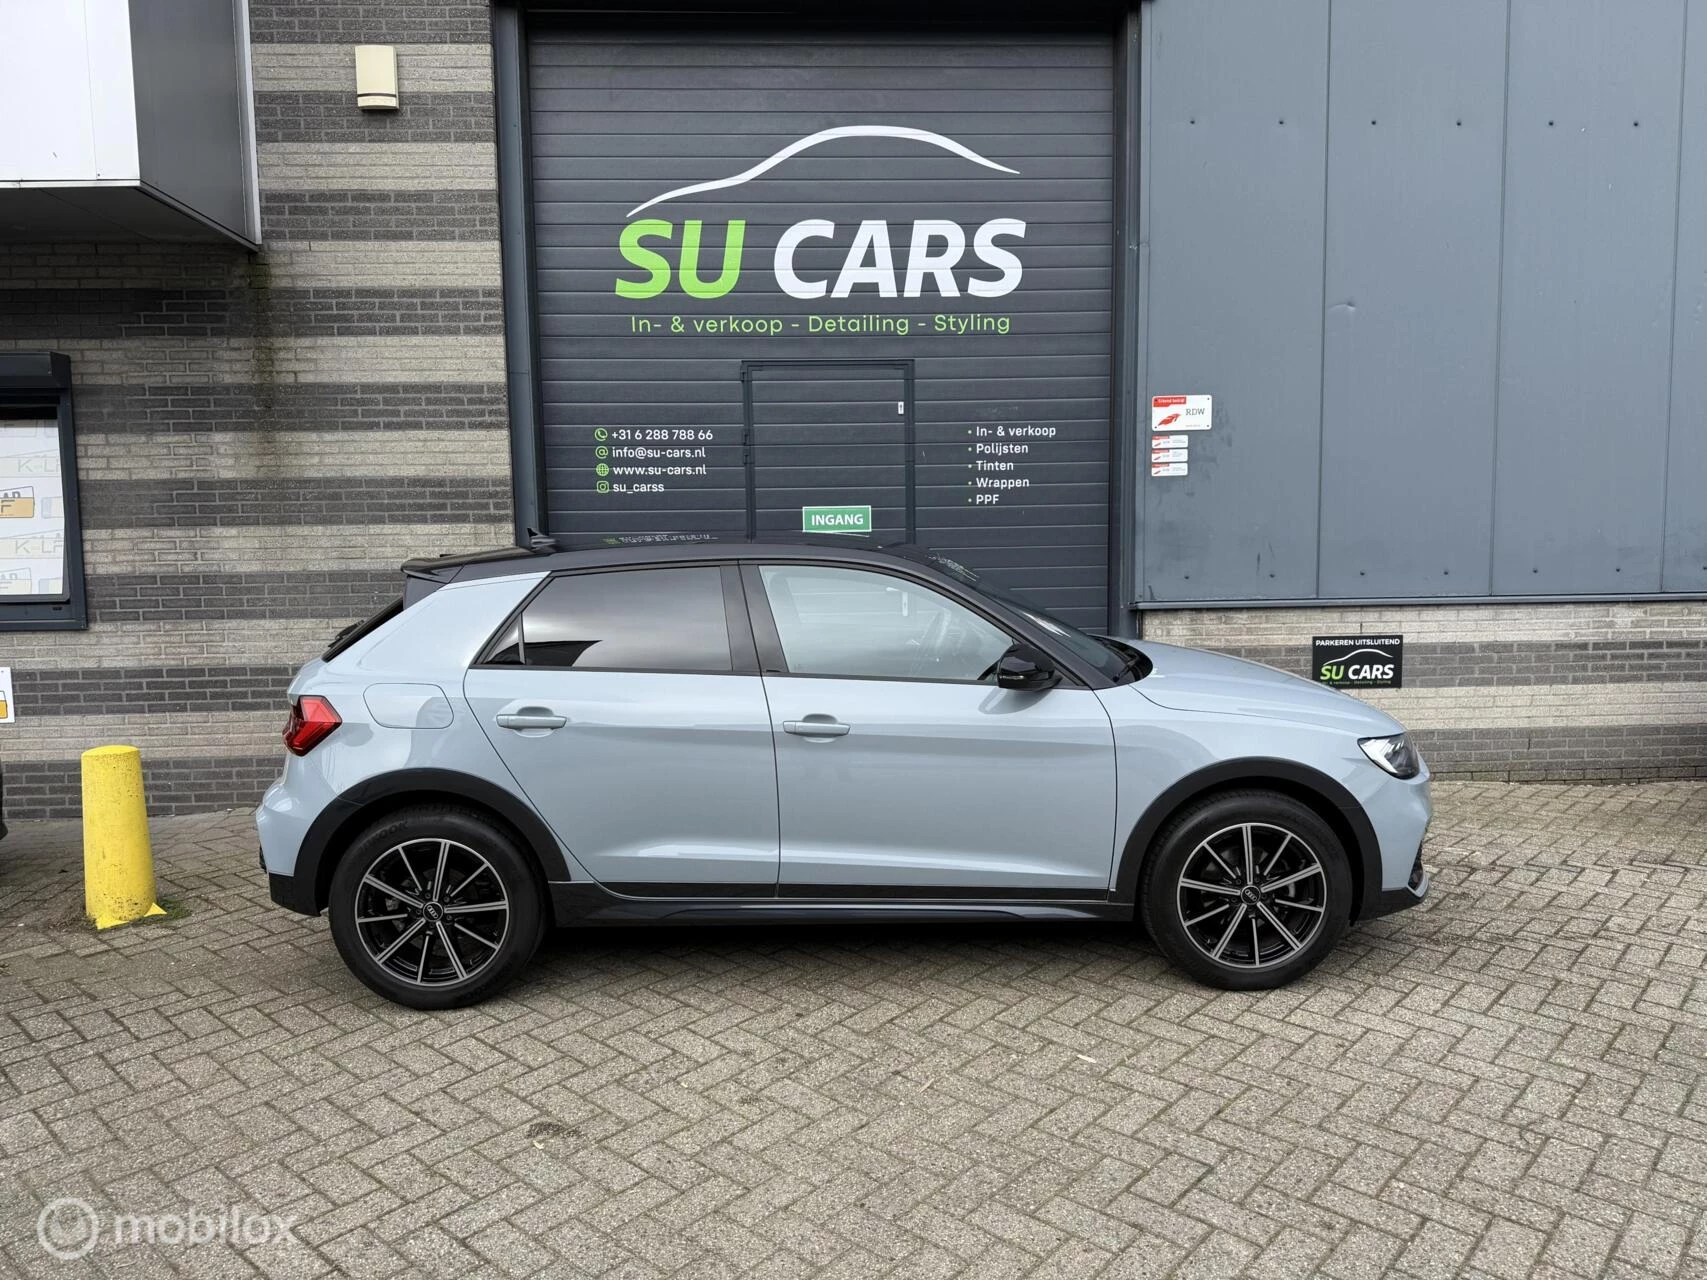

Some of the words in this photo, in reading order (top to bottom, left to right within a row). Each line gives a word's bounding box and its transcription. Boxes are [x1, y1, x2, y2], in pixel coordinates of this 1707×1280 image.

[615, 219, 746, 299] SU
[774, 218, 1026, 299] CARS
[632, 316, 661, 333] In-
[671, 316, 685, 333] &
[694, 316, 782, 335] verkoop
[809, 315, 909, 334] Detailing
[934, 314, 1010, 333] Styling
[612, 430, 631, 440] +31
[635, 430, 642, 440] 6
[646, 430, 668, 440] 288
[672, 430, 694, 440] 788
[698, 430, 713, 440] 66
[976, 426, 992, 436] In-
[997, 426, 1005, 436] &
[1009, 426, 1056, 438] verkoop
[612, 447, 705, 459] info@su-cars.nl
[976, 444, 1028, 456] Polijsten
[613, 465, 706, 475] www.su-cars.nl
[976, 461, 1013, 470] Tinten
[613, 484, 664, 494] su_carss
[976, 478, 1029, 489] Wrappen
[976, 495, 999, 504] PPF
[811, 514, 864, 526] INGANG
[1320, 665, 1344, 680] SU
[1348, 664, 1394, 679] CARS
